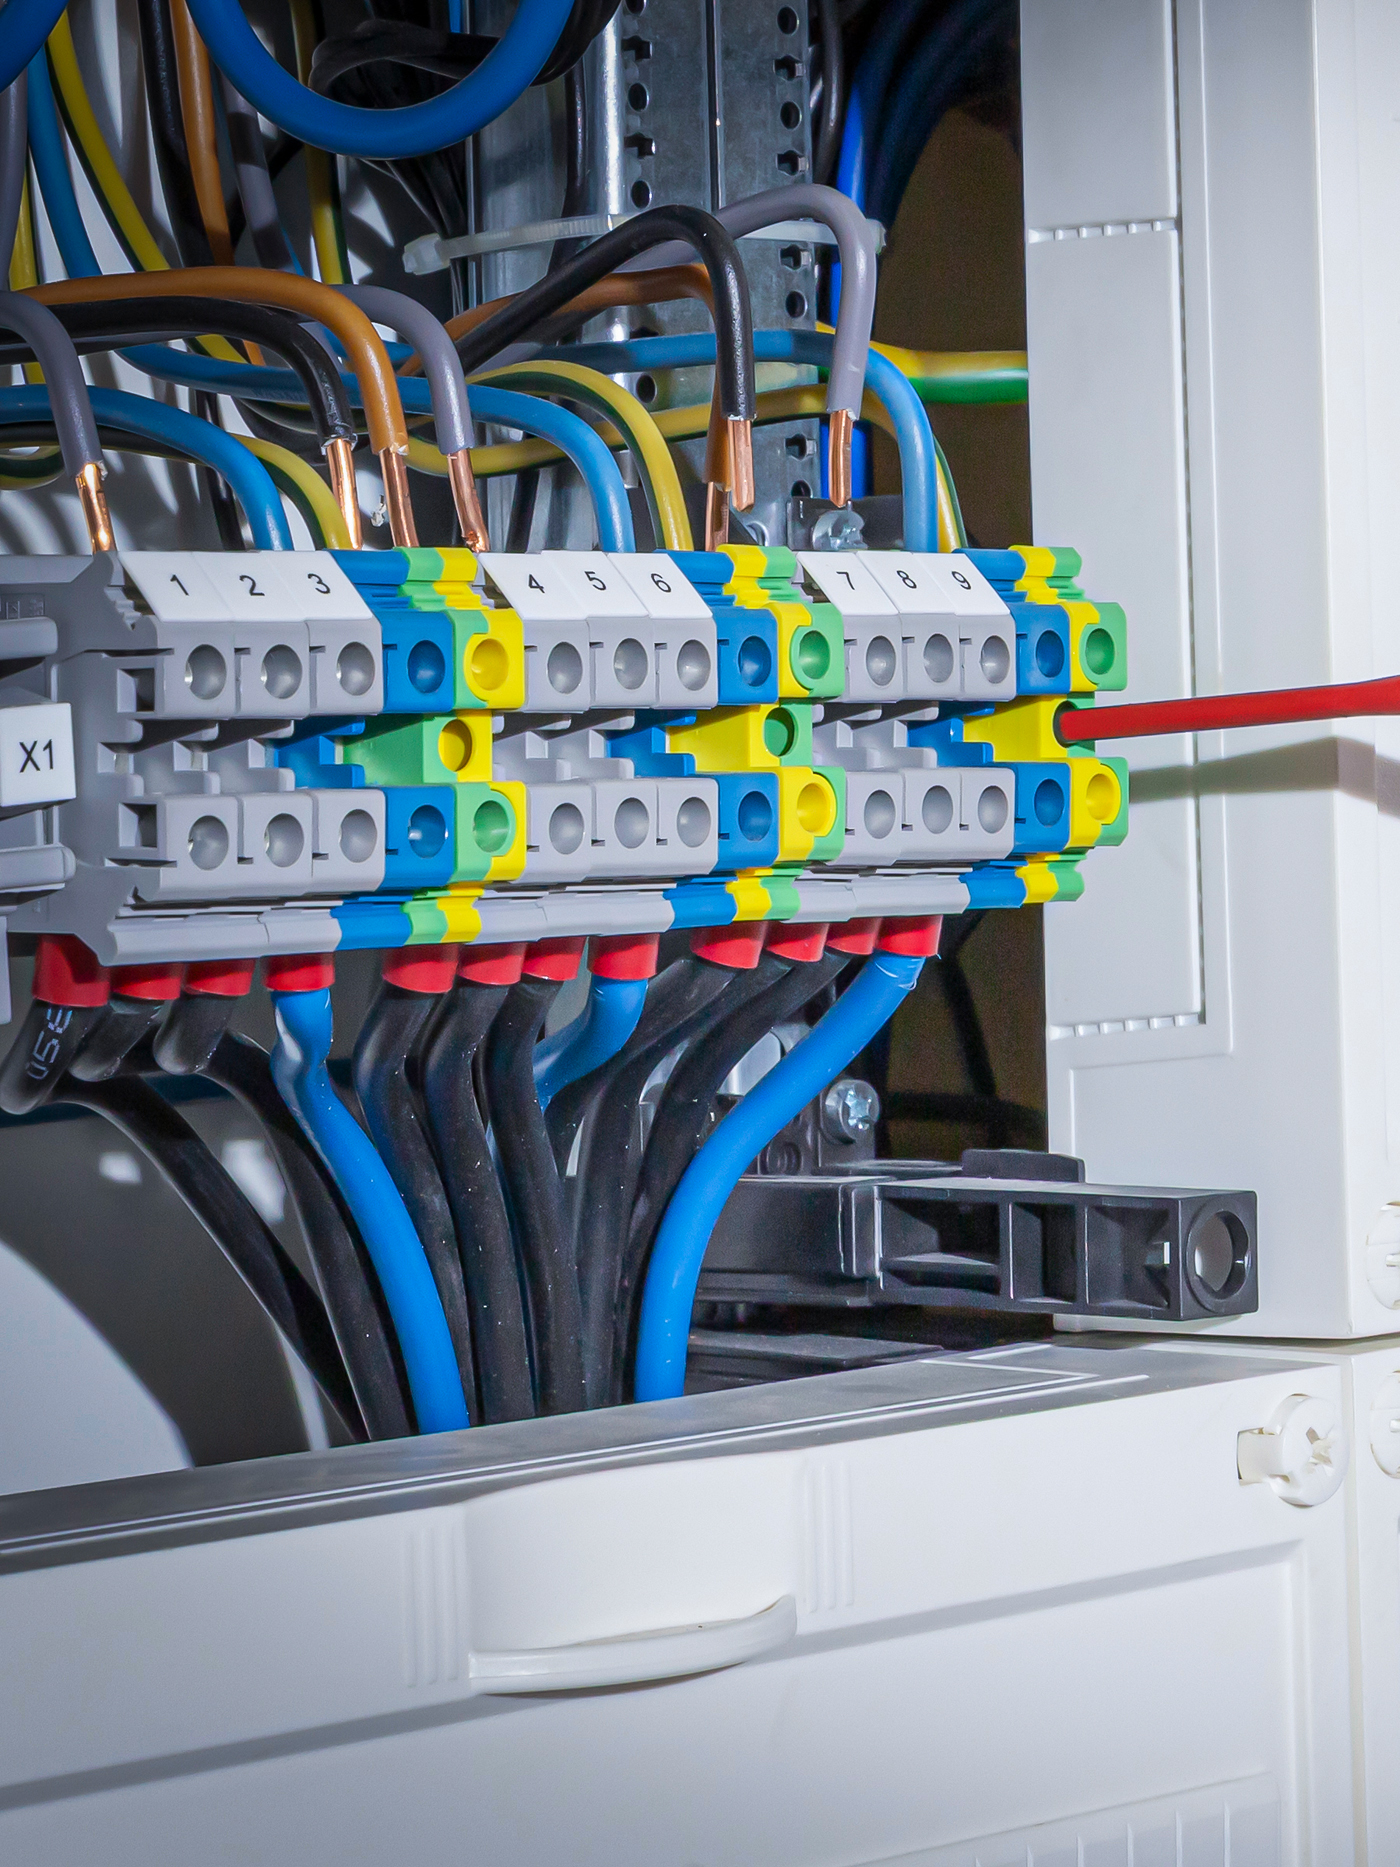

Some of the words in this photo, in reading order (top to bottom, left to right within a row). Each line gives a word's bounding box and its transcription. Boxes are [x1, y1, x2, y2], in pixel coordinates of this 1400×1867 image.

[170, 573, 189, 596] 1
[239, 574, 265, 596] 2
[307, 573, 331, 594] 3
[528, 573, 545, 594] 4
[584, 570, 607, 591] 5
[650, 572, 672, 593] 6
[836, 571, 856, 591] 7
[896, 570, 917, 589] 8
[951, 570, 972, 590] 9
[19, 738, 54, 773] X1
